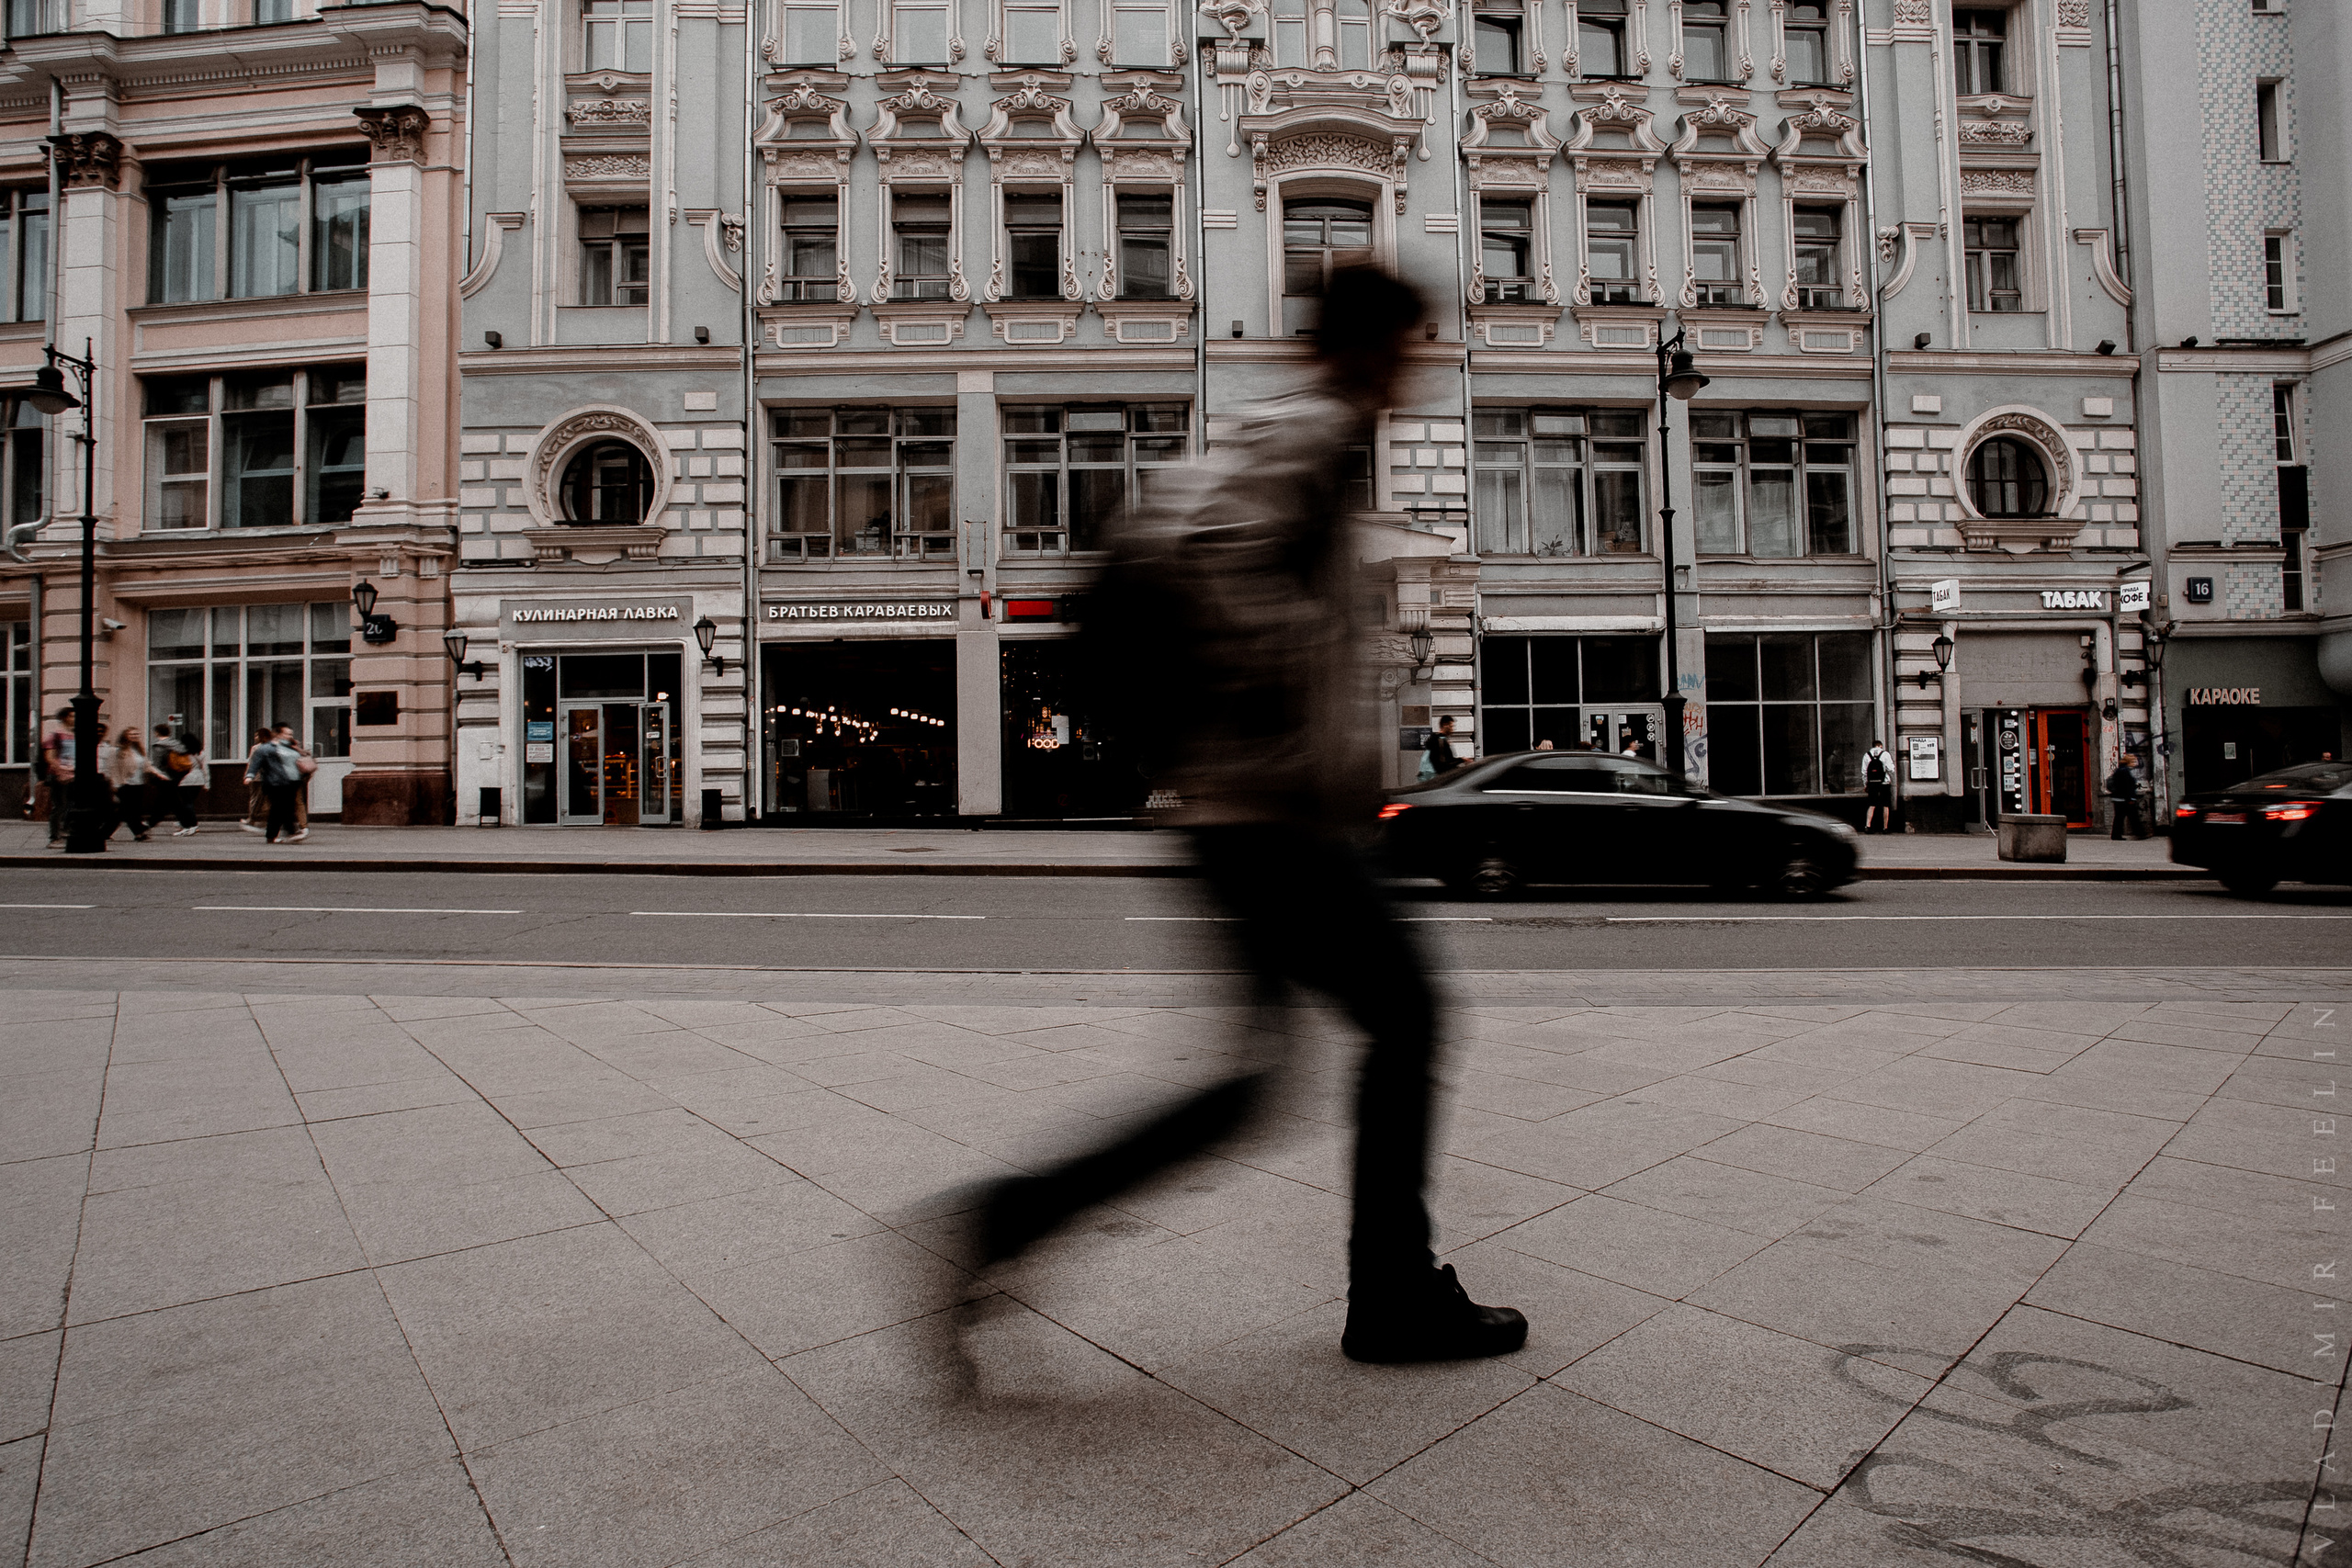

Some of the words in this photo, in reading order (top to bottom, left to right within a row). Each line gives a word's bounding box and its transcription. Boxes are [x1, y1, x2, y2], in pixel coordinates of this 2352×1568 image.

[1932, 588, 1951, 603] ТАБАК
[2195, 582, 2210, 595] 16
[2041, 591, 2103, 608] ТАБАК
[513, 608, 618, 622] КУЛИНАРНАЯ
[623, 606, 679, 620] ЛАВКА
[768, 605, 839, 618] БРАТЬЕВ
[843, 604, 952, 617] КАРАВАЕВЫХ
[2189, 687, 2260, 705] КАРАОКЕ
